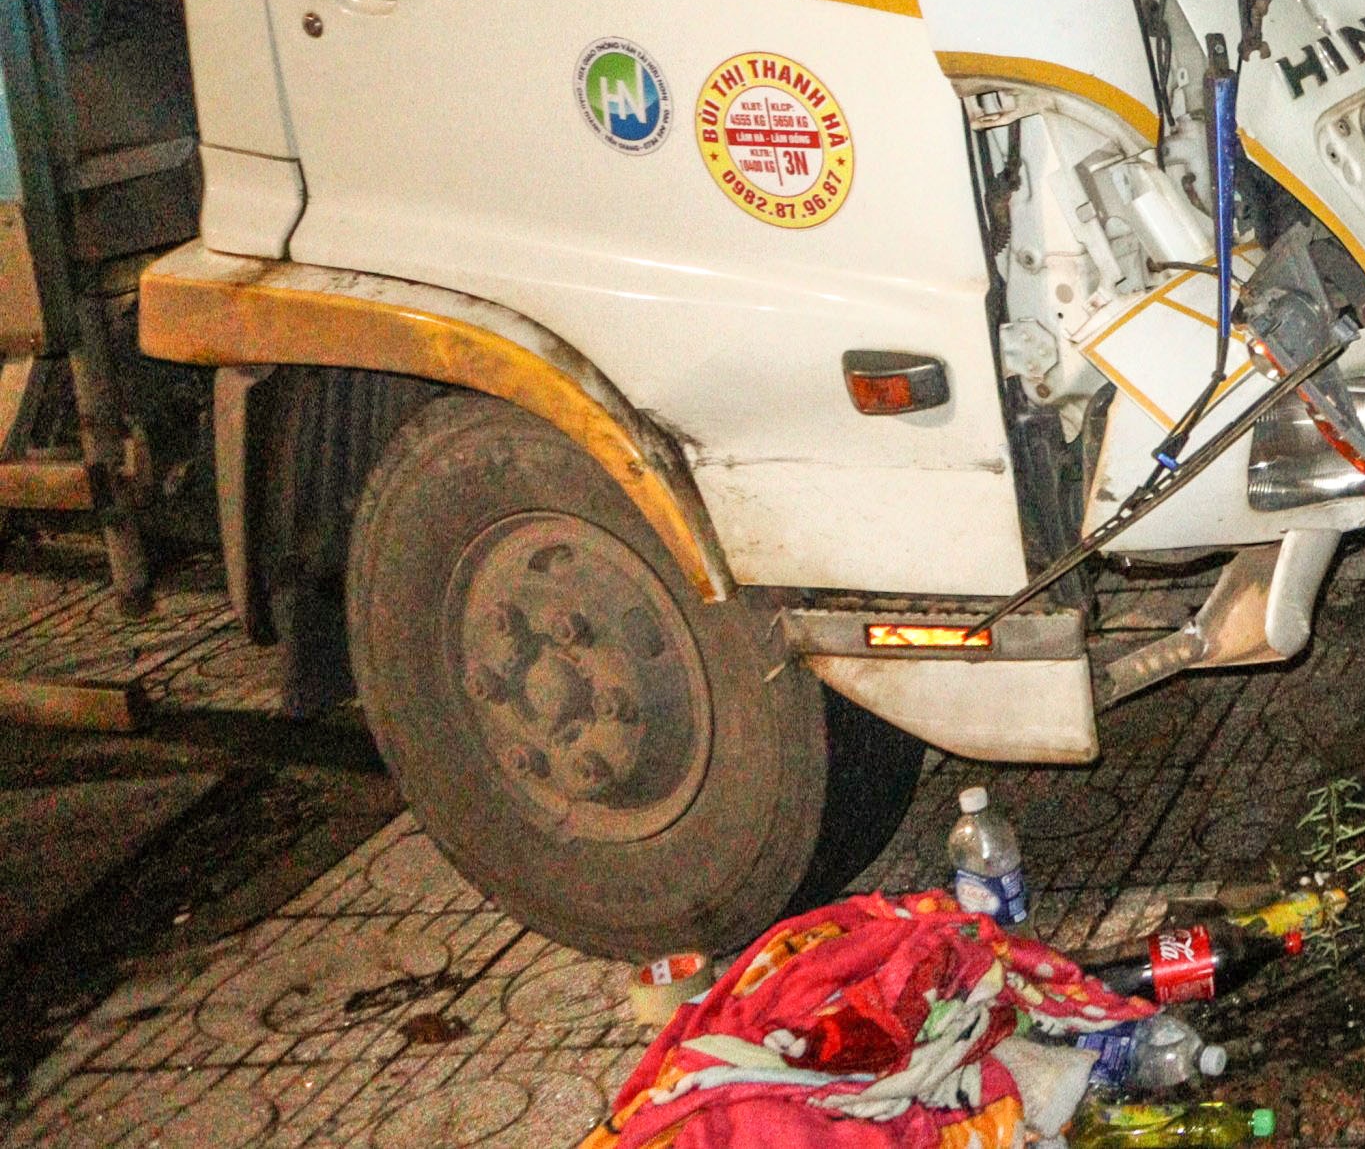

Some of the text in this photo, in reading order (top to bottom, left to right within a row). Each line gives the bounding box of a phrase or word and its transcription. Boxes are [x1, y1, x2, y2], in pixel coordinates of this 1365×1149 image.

[698, 100, 720, 144] BÙI
[711, 63, 747, 98] THỊ
[747, 59, 827, 110] THANH
[821, 112, 851, 148] HÀ
[783, 150, 809, 176] 3N
[721, 169, 845, 219] 0982.87.96.87
